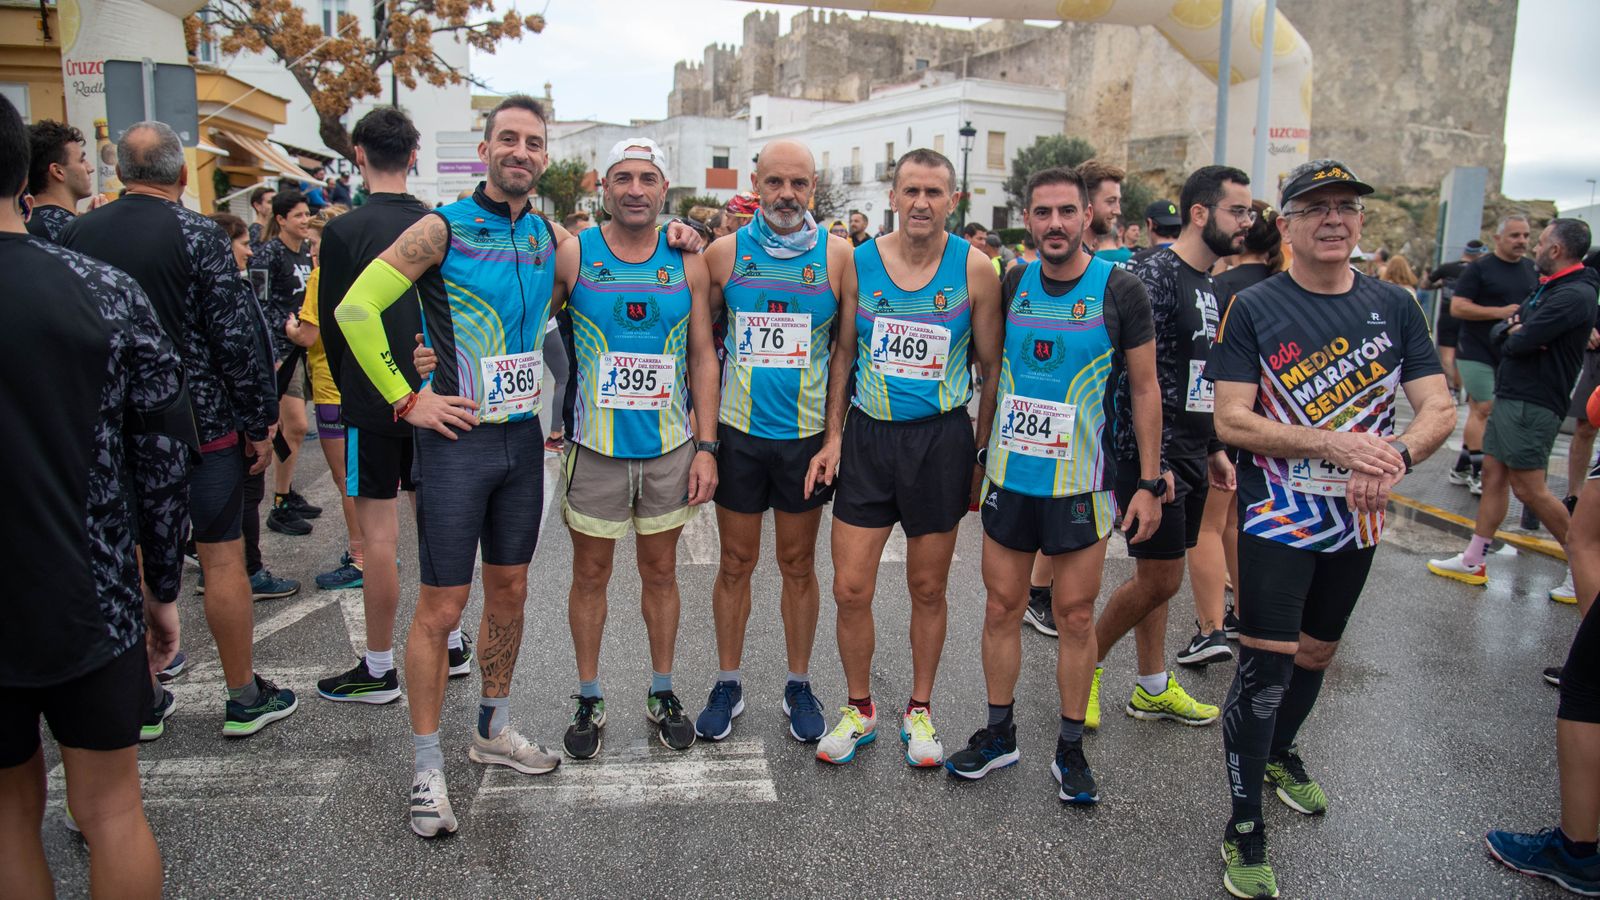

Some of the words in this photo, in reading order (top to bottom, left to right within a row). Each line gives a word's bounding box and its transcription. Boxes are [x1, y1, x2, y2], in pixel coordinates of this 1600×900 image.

[747, 316, 770, 327] XIV
[886, 322, 910, 336] XIV
[909, 326, 934, 334] CARRERA
[759, 327, 784, 349] 76
[889, 335, 928, 360] 469
[495, 358, 518, 372] XIV
[613, 355, 638, 368] XIV
[1269, 341, 1302, 370] edp
[1280, 336, 1350, 390] MEDIO
[618, 367, 657, 391] 395
[1292, 331, 1393, 406] MARATÓN
[503, 367, 535, 395] 369
[1304, 360, 1388, 421] SEVILLA
[1011, 399, 1033, 413] XIV
[1033, 403, 1058, 411] CARRERA
[1014, 412, 1052, 439] 284
